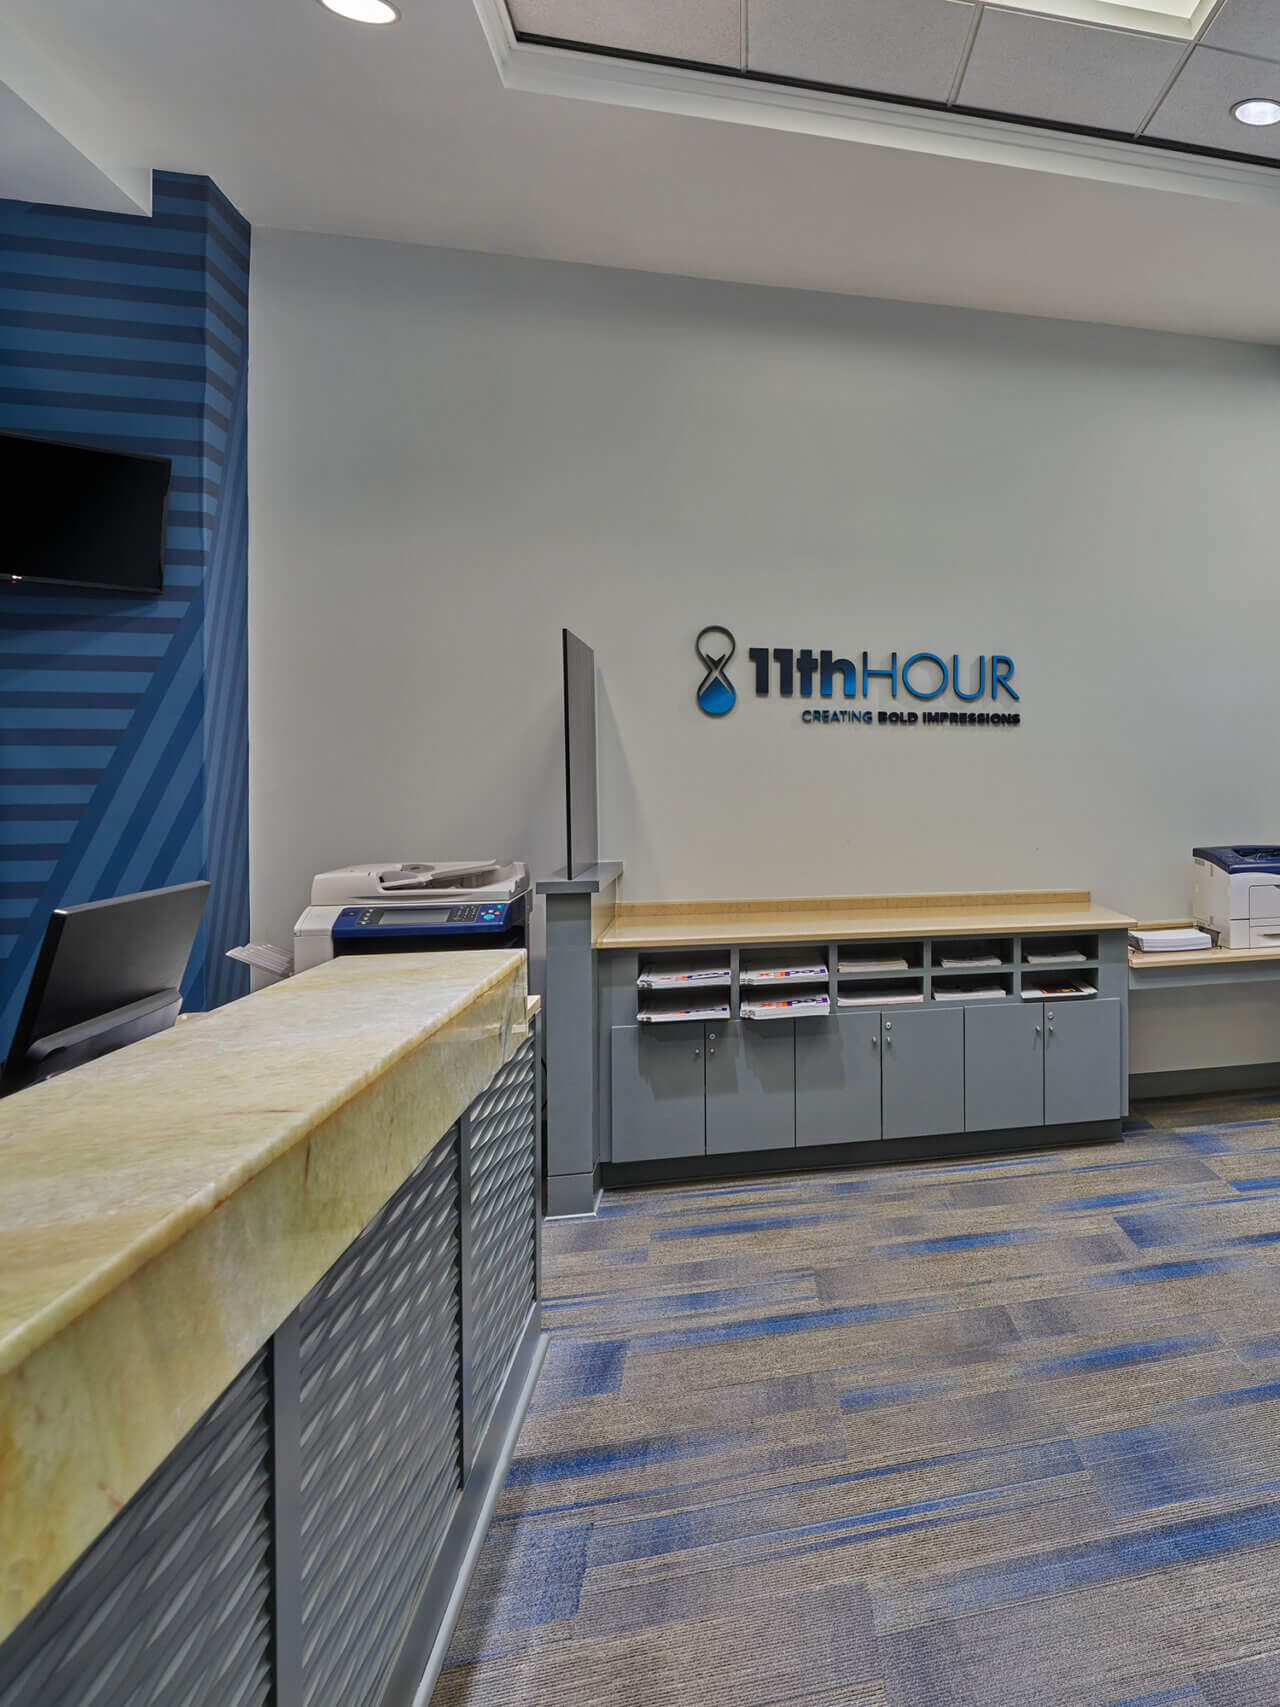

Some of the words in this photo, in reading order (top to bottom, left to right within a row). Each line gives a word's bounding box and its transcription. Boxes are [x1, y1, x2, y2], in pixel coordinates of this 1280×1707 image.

[749, 647, 1020, 700] 11thHOUR
[801, 710, 873, 724] CREATING
[877, 711, 918, 726] BOLD
[922, 712, 1021, 727] IMPRESSIONS
